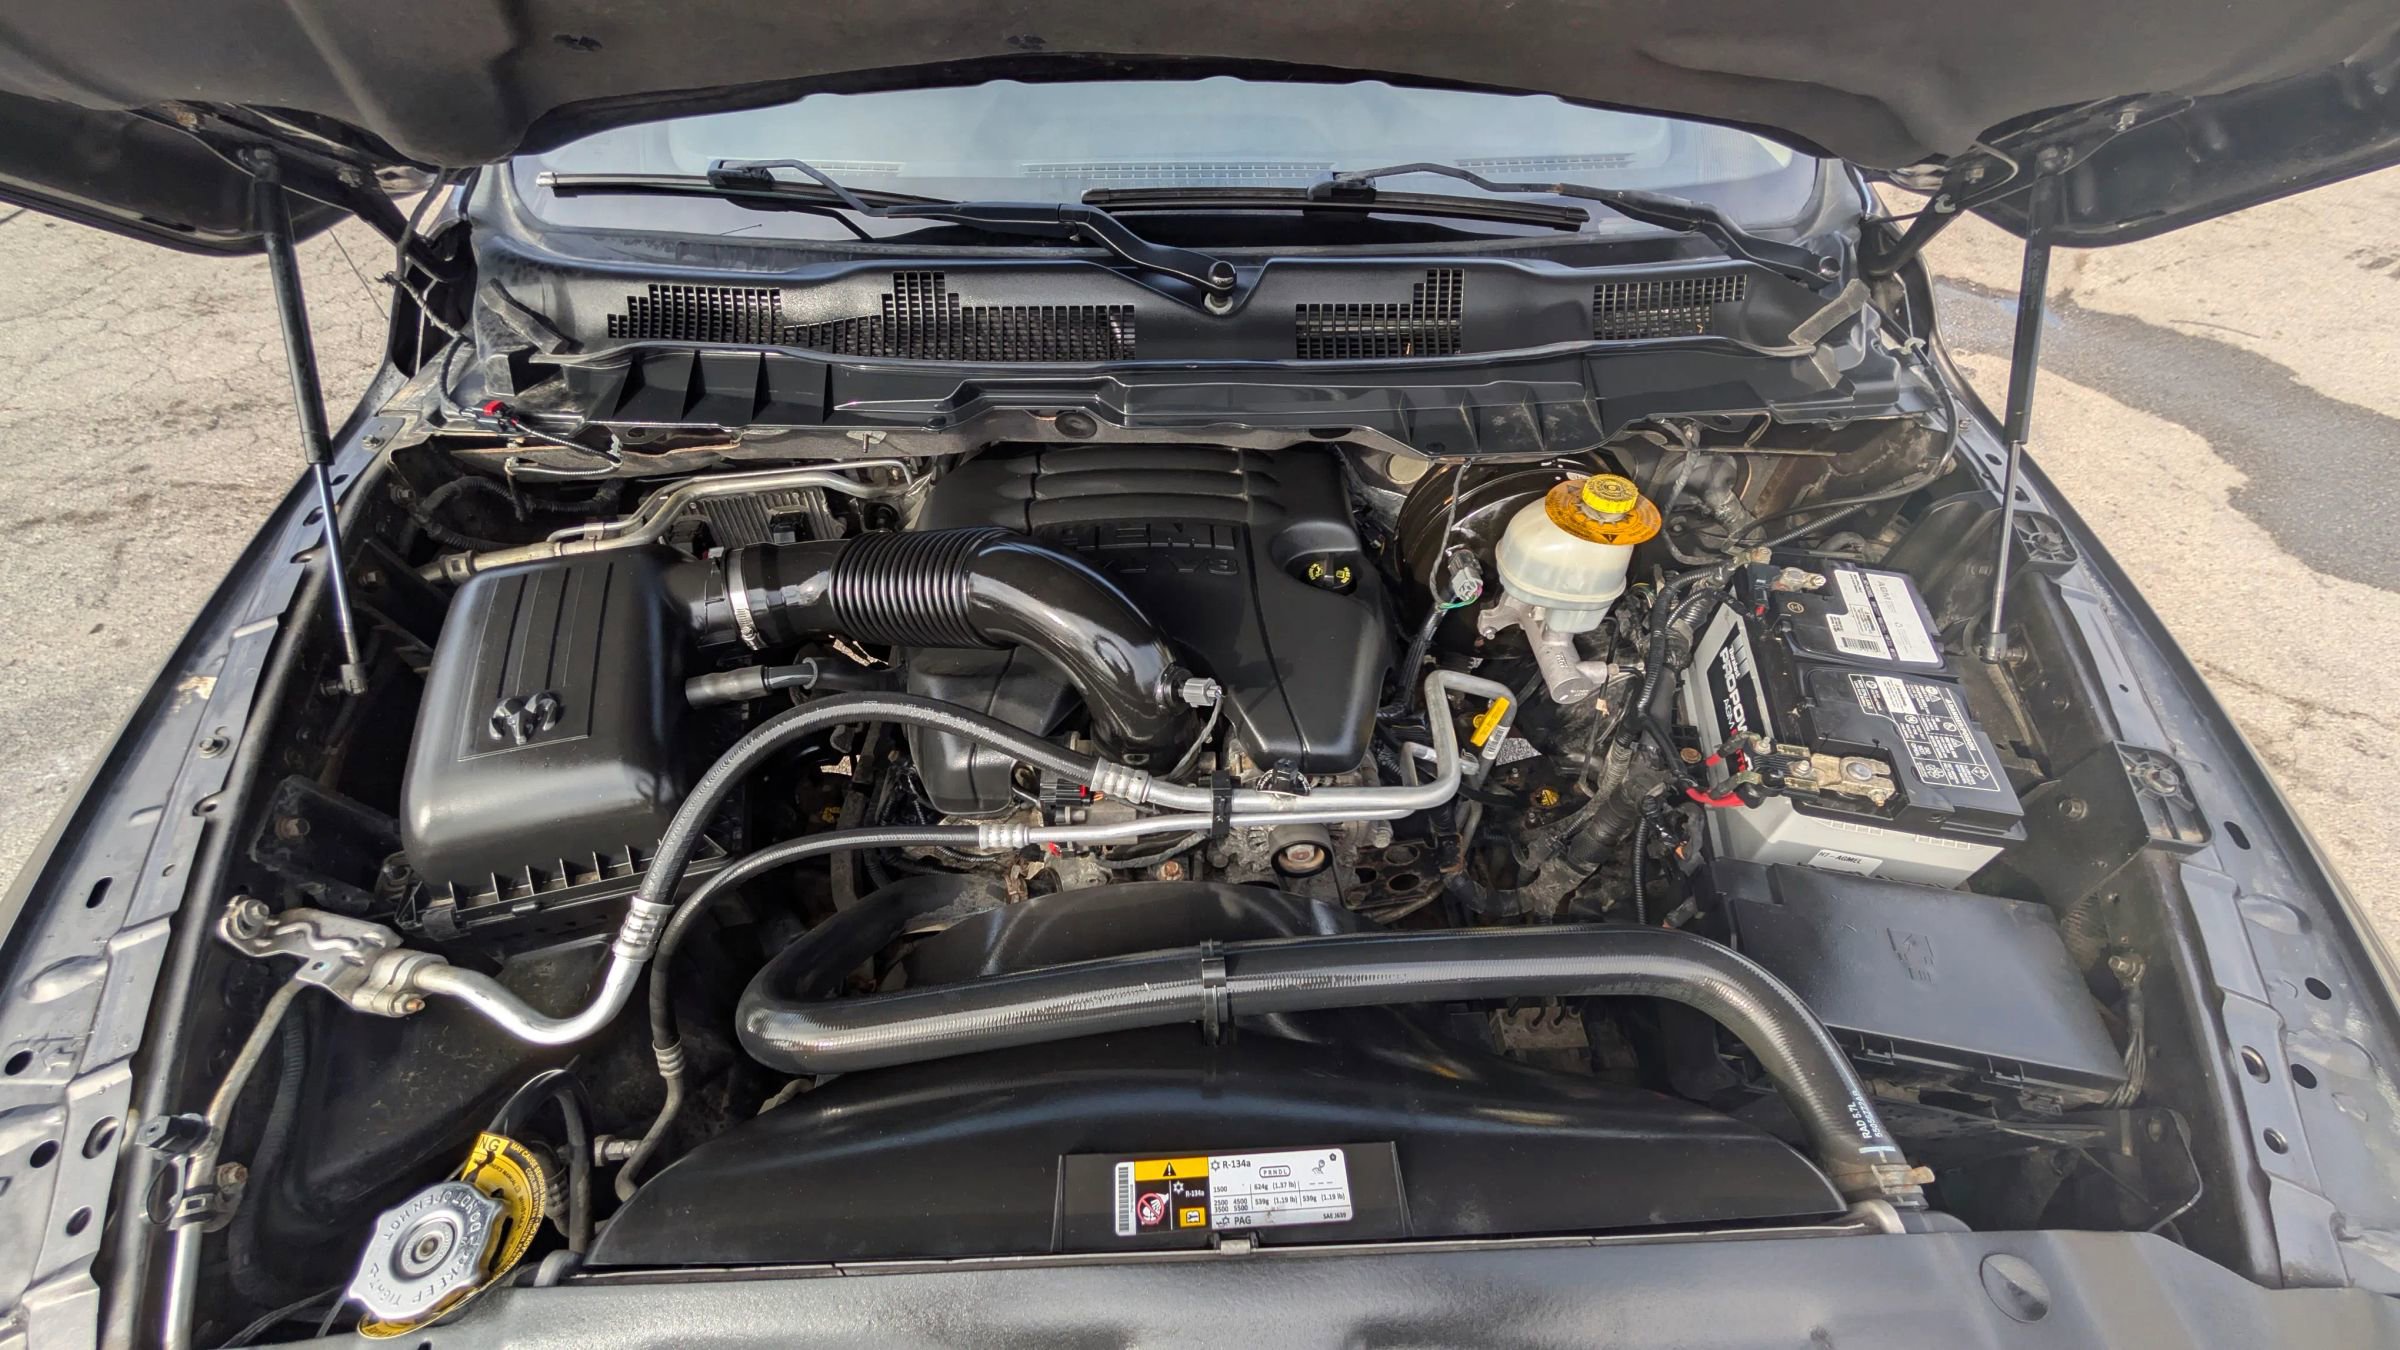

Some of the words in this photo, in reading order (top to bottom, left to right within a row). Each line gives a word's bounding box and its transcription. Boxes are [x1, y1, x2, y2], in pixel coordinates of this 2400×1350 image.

[1847, 1101, 1862, 1119] 5.7L
[1856, 1119, 1872, 1139] RAD
[1222, 1159, 1251, 1169] R-134a
[1234, 1216, 1252, 1225] PAG
